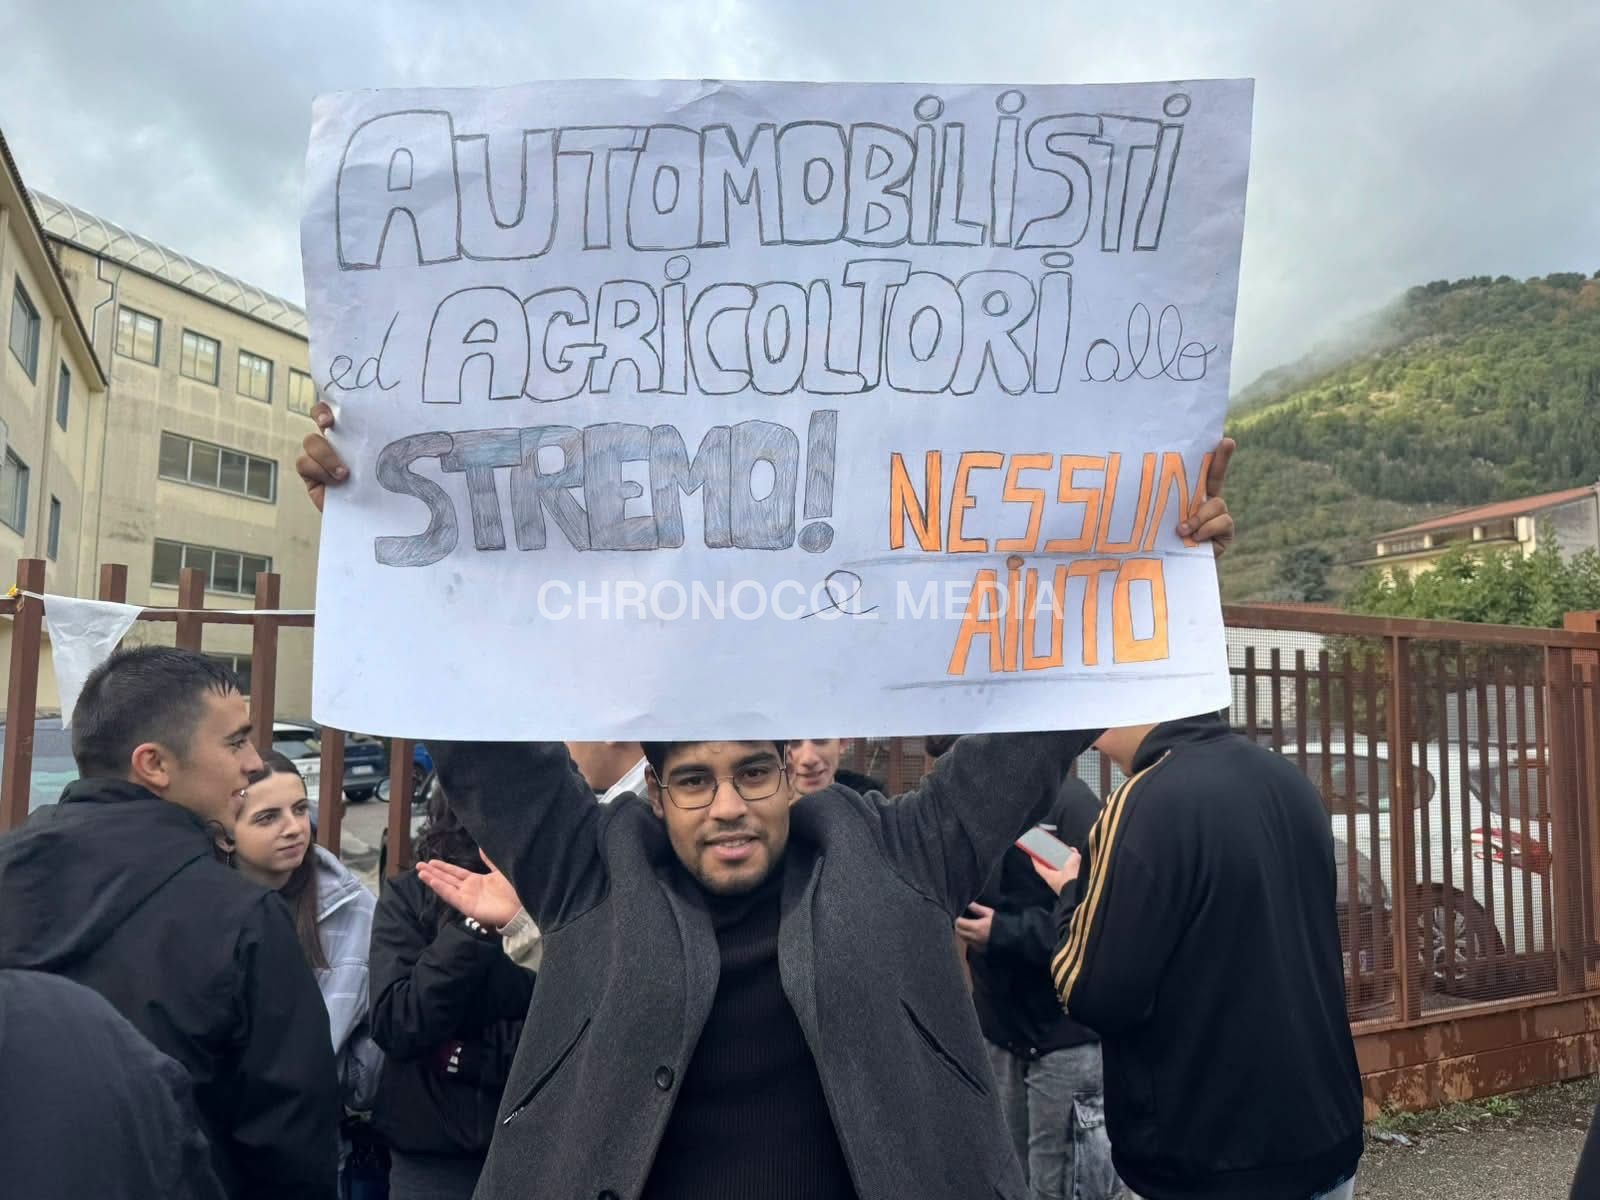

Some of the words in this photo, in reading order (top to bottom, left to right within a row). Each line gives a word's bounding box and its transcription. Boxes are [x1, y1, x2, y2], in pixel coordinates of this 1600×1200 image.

[323, 311, 402, 392] ed
[1080, 302, 1218, 382] allo
[374, 409, 838, 568] STREMO!
[889, 450, 1216, 553] NESSUN
